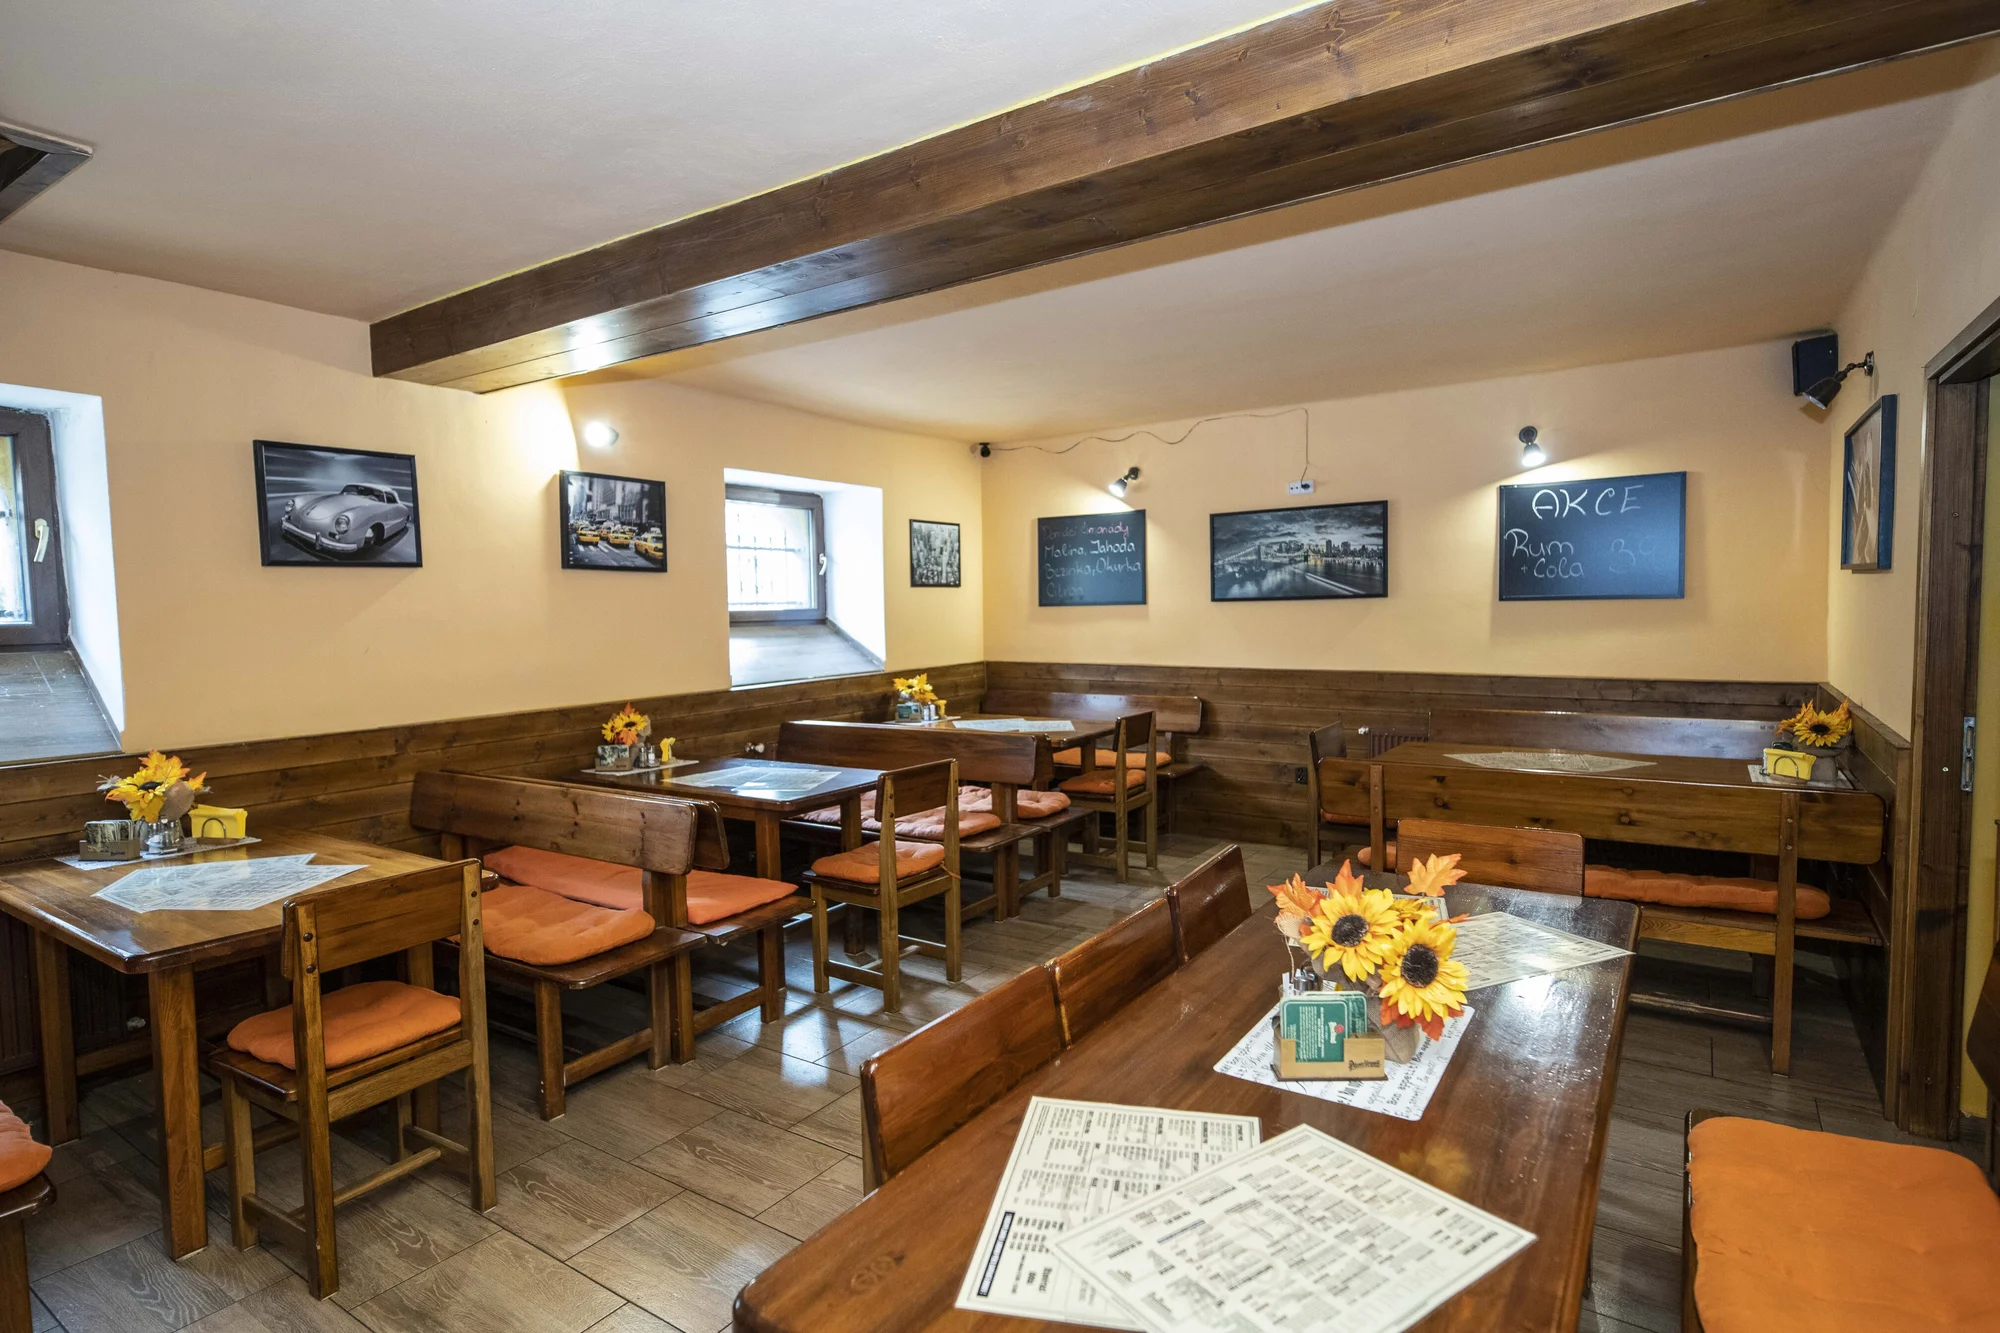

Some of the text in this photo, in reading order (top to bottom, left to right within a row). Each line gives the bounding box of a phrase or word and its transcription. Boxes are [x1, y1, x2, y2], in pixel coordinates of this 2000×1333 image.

[1531, 484, 1645, 520] AKCE
[1090, 539, 1136, 555] Jahoda
[1503, 528, 1575, 558] Rum
[1095, 556, 1142, 574] Okurka
[1533, 556, 1585, 579] Cola
